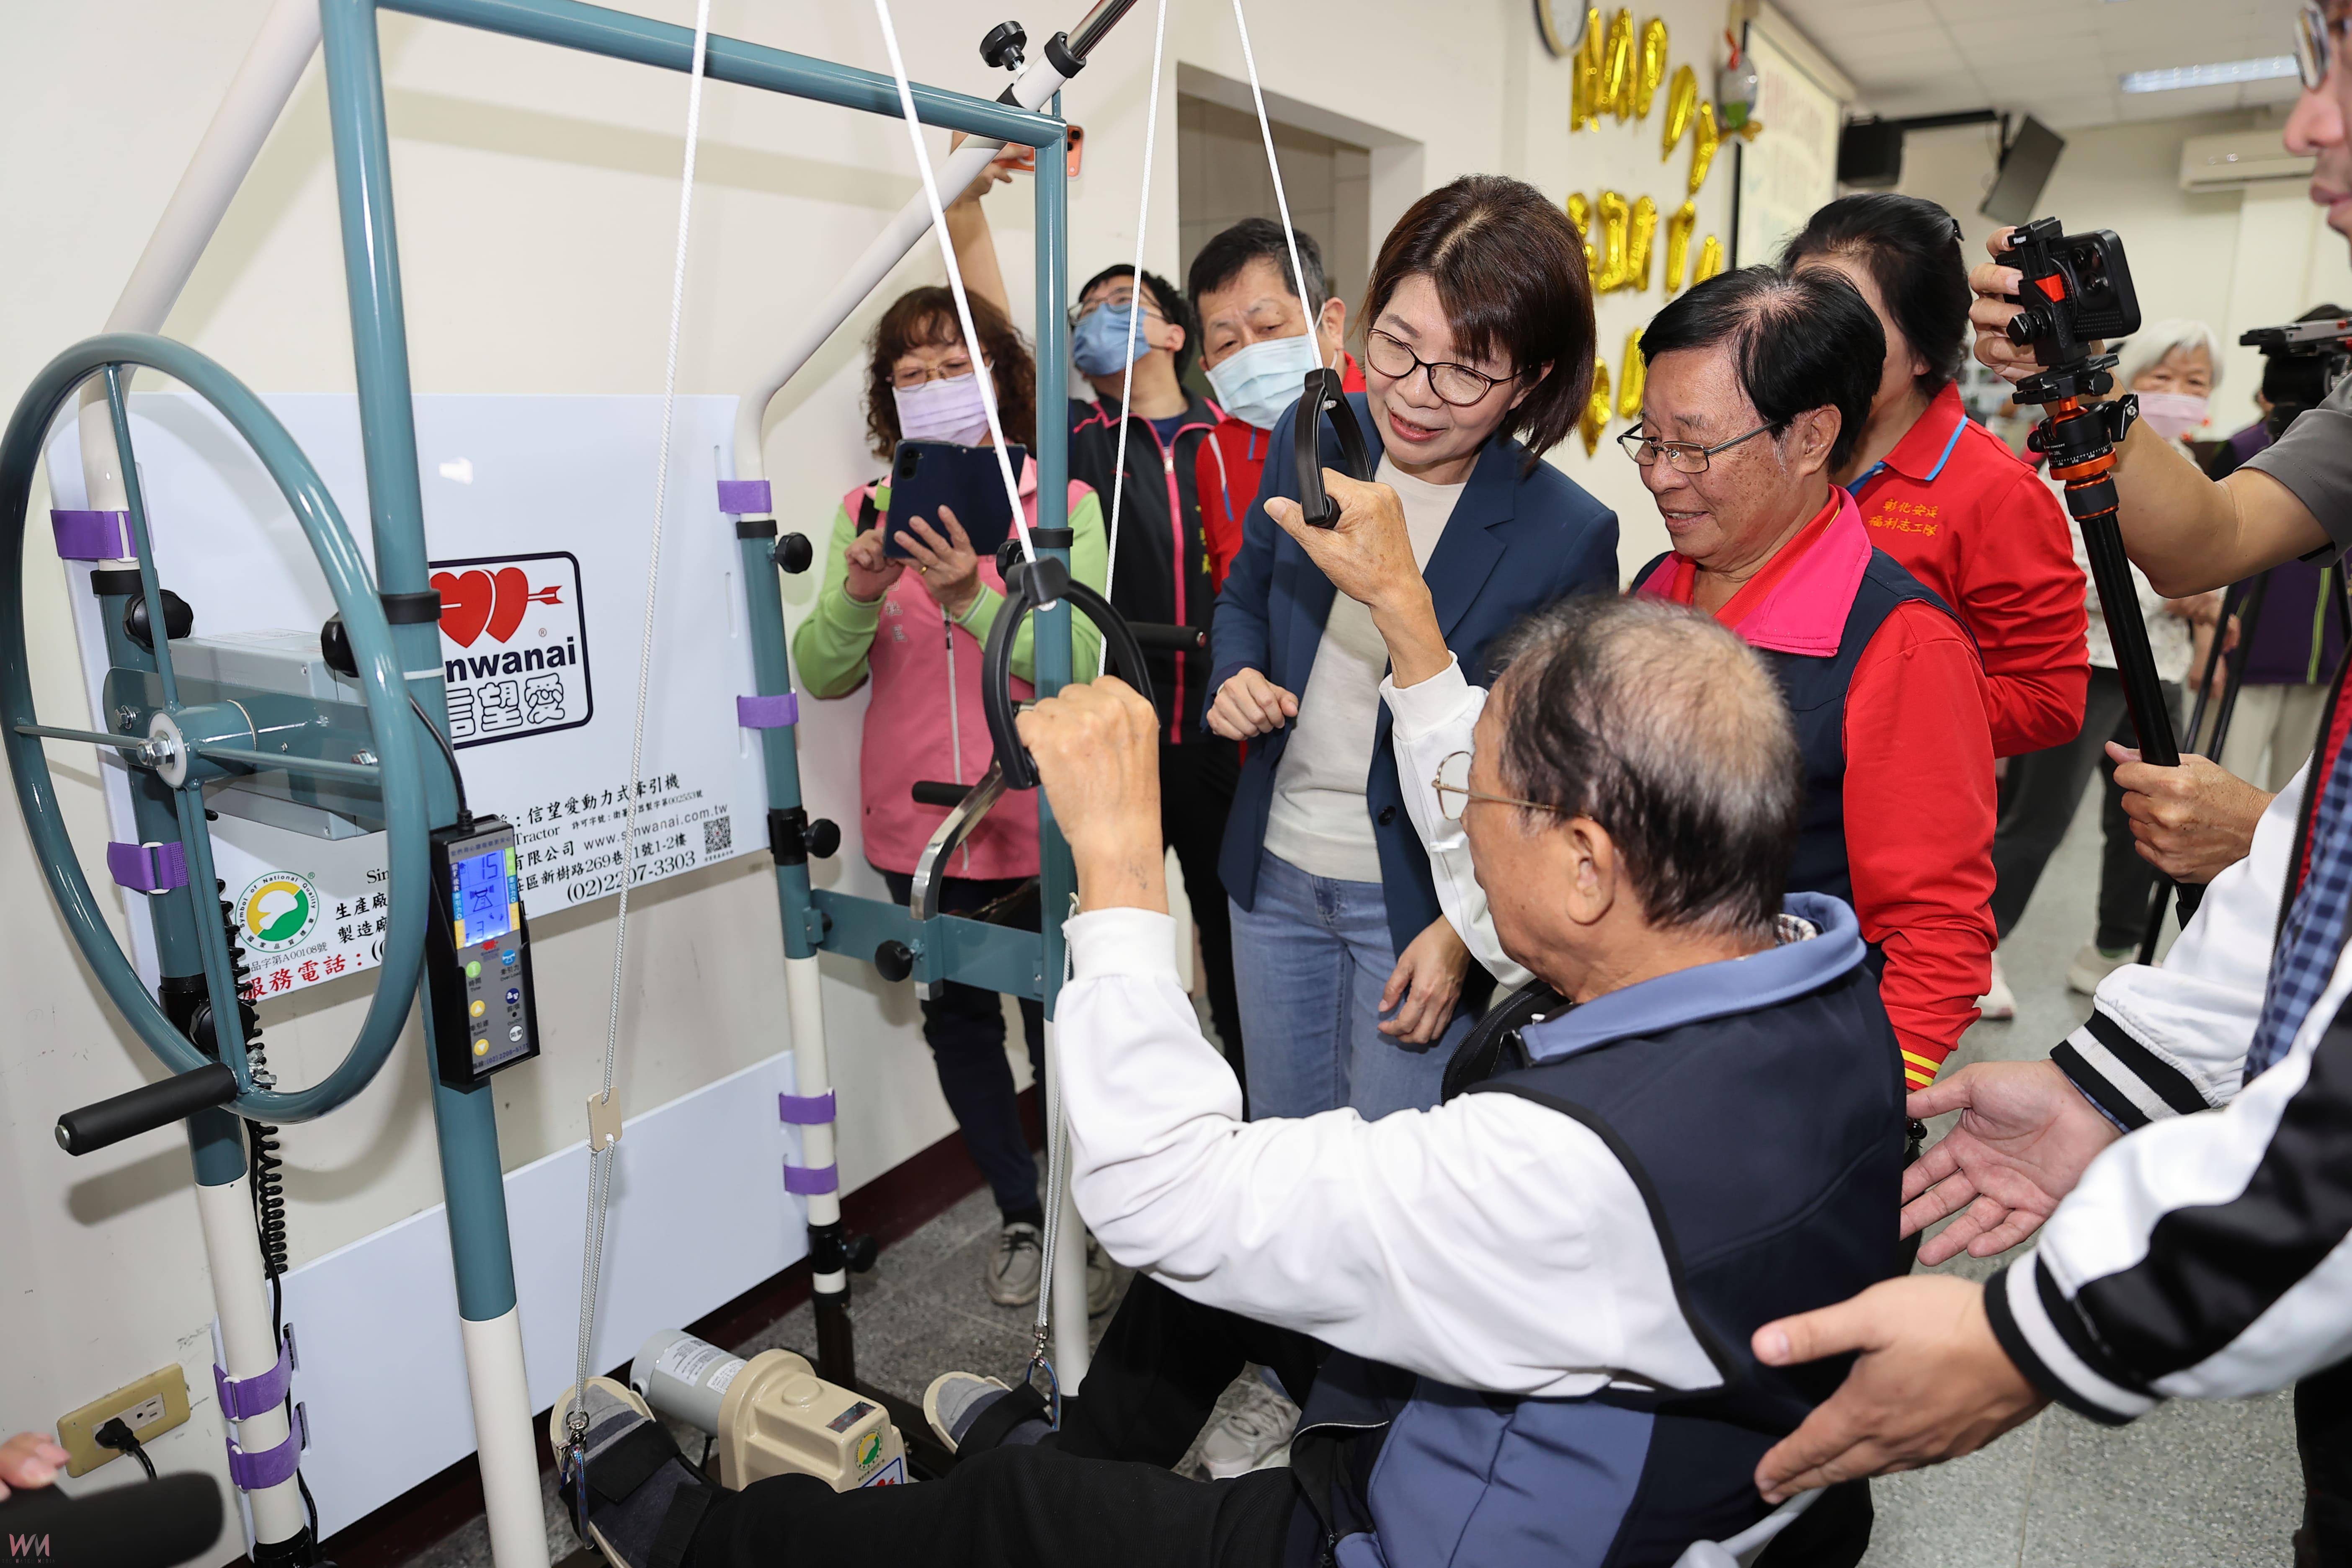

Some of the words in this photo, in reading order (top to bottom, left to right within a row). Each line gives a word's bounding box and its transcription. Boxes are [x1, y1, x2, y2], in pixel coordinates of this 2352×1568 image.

[583, 804, 728, 851] www.snwanai.com.tw
[482, 852, 498, 880] 15
[240, 897, 248, 928] Symbol
[250, 885, 258, 893] of
[263, 875, 299, 884] National
[302, 882, 316, 909] Quality
